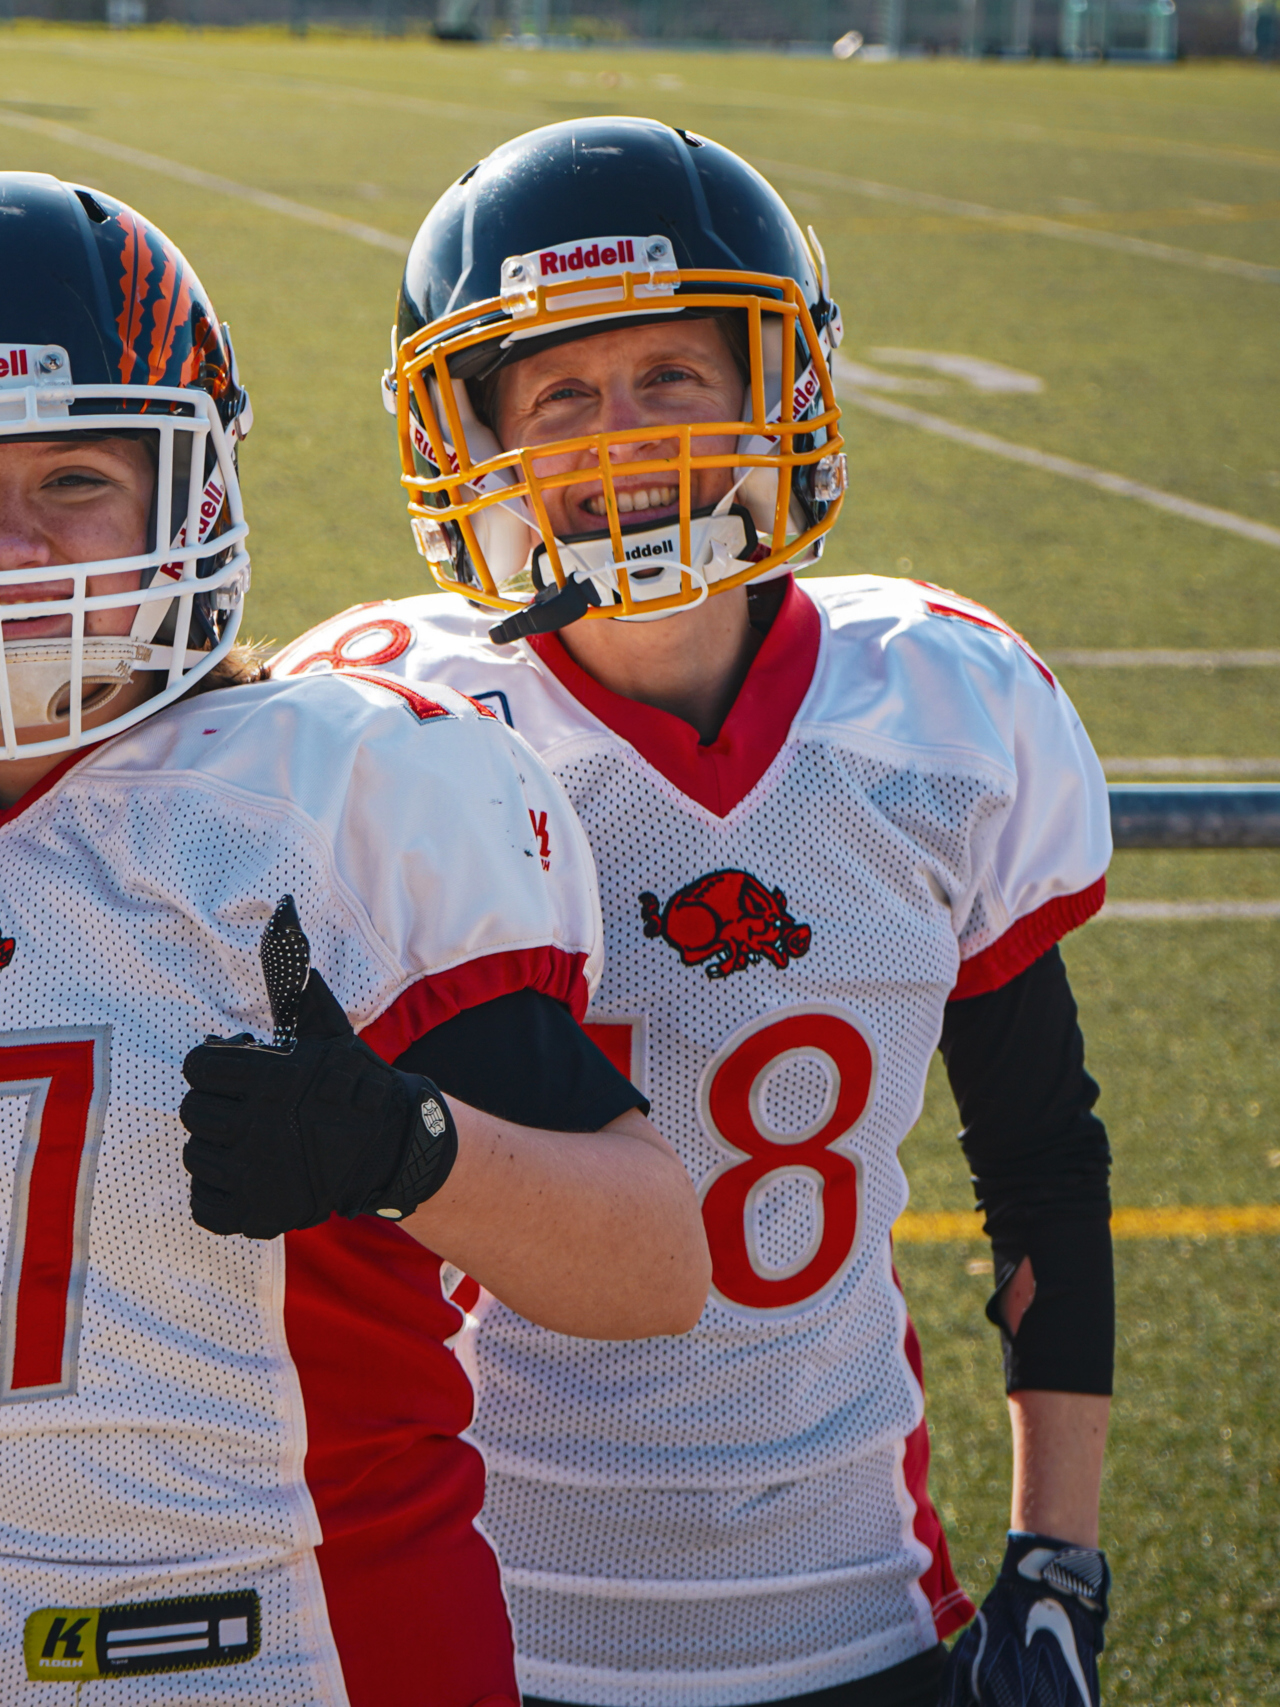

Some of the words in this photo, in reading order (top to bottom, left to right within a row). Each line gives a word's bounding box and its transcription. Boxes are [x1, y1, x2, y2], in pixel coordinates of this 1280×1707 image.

[539, 239, 635, 276] Riddell
[612, 539, 673, 560] iddell
[578, 1002, 878, 1320] 8
[41, 1617, 91, 1658] K
